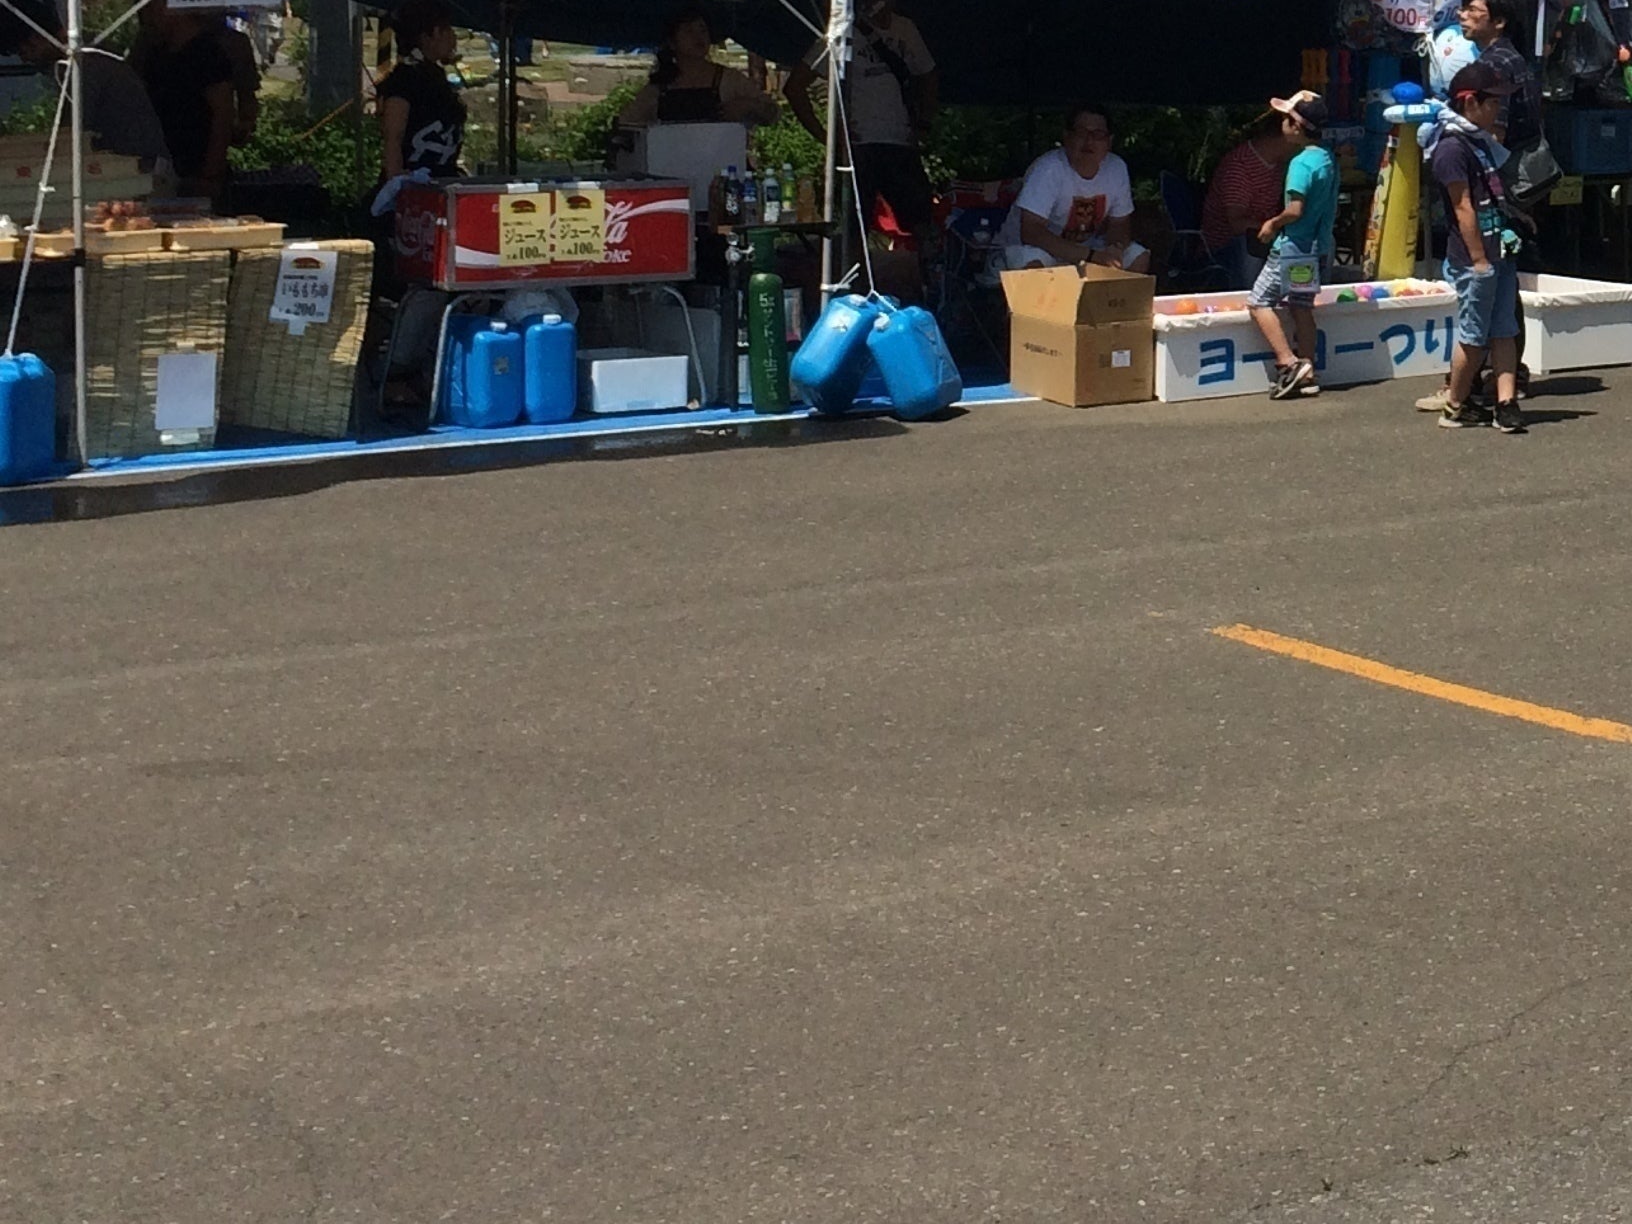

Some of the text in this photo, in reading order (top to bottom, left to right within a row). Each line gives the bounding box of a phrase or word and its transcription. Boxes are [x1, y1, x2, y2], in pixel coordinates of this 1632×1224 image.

[504, 229, 546, 244] ジュース
[560, 223, 600, 240] ジュース
